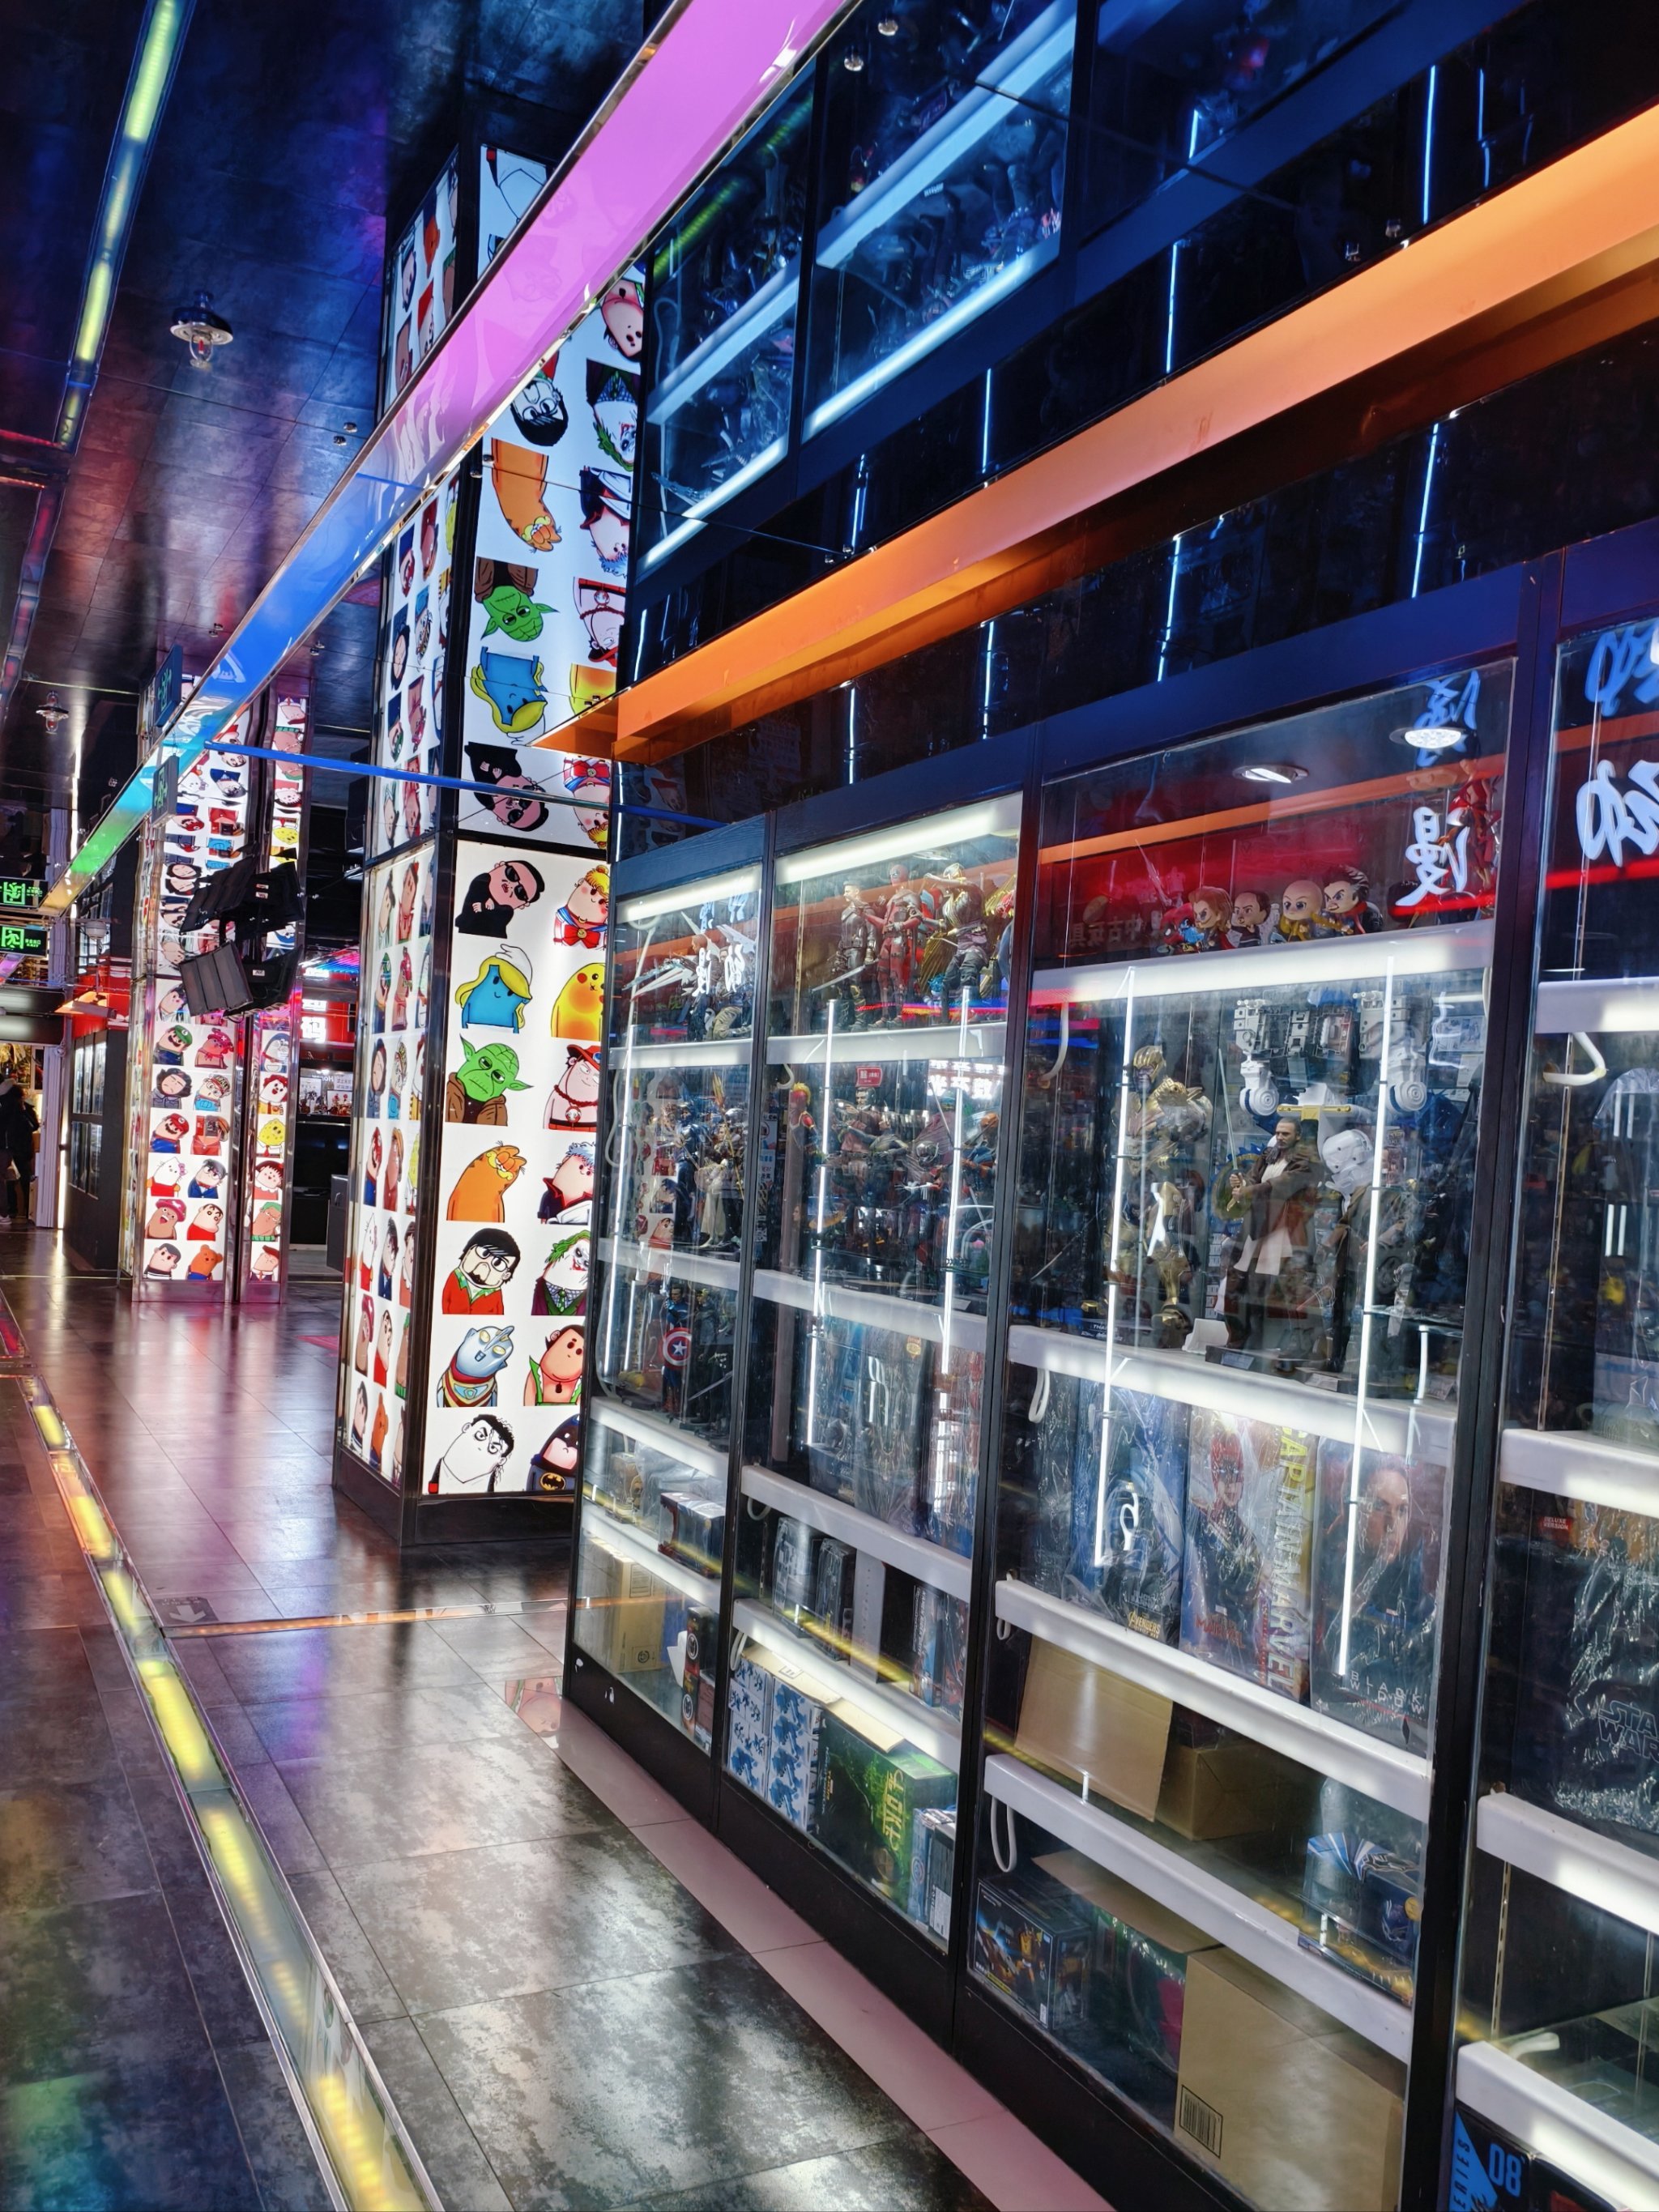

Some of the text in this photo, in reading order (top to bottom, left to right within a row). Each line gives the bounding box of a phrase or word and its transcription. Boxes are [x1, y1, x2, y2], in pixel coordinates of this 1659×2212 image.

[1128, 1610, 1161, 1634] AVENGERS
[1266, 1558, 1302, 1690] MARVEL
[1598, 1700, 1659, 1739] STA
[1598, 1717, 1659, 1764] WAR
[1453, 2138, 1470, 2212] ERIES
[1489, 2143, 1521, 2198] 08
